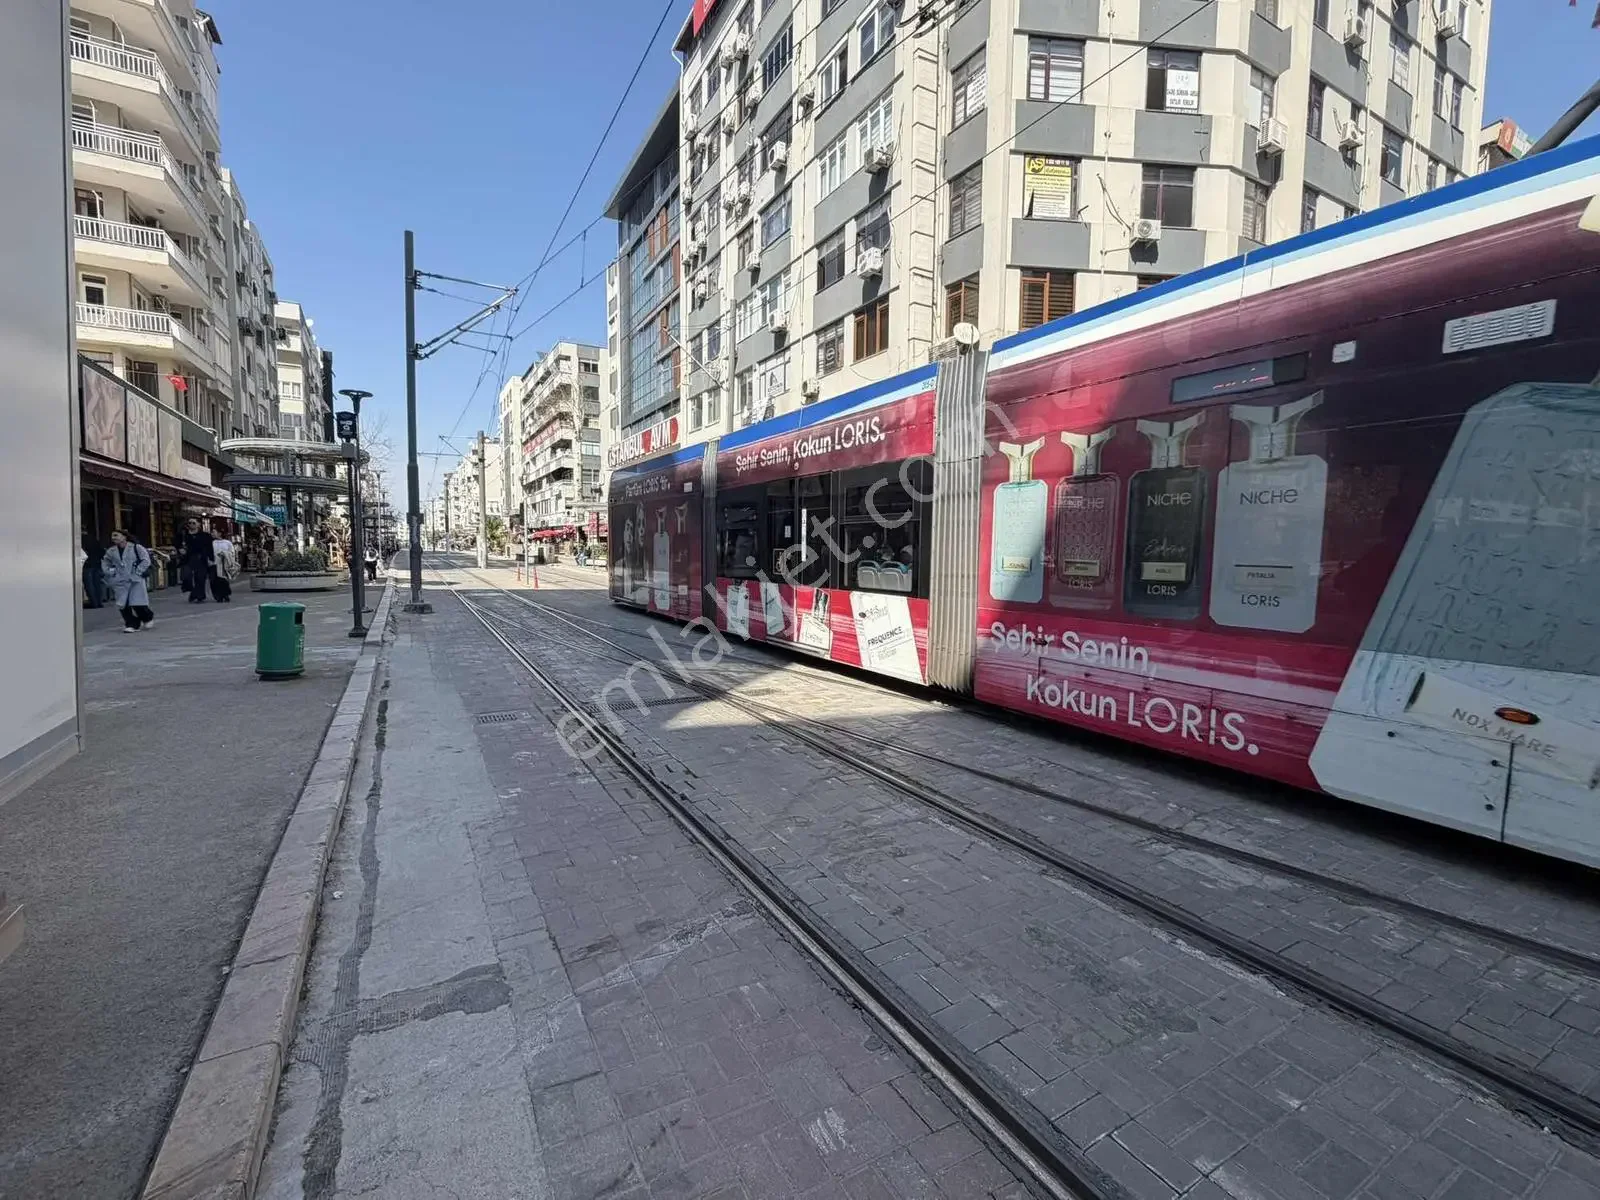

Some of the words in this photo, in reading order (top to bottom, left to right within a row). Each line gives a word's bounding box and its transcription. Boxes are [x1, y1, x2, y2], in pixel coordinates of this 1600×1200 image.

[793, 436, 832, 459] Kokun
[835, 416, 886, 450] LORIS.
[1146, 584, 1177, 597] LORIS
[1241, 594, 1281, 608] LORIS
[867, 625, 903, 646] FREQUENCE
[1061, 630, 1157, 681] Senin,
[1026, 673, 1117, 722] Kokun
[1127, 691, 1260, 756] LORIS.
[1452, 707, 1493, 732] NOX
[1496, 726, 1558, 758] MARE
